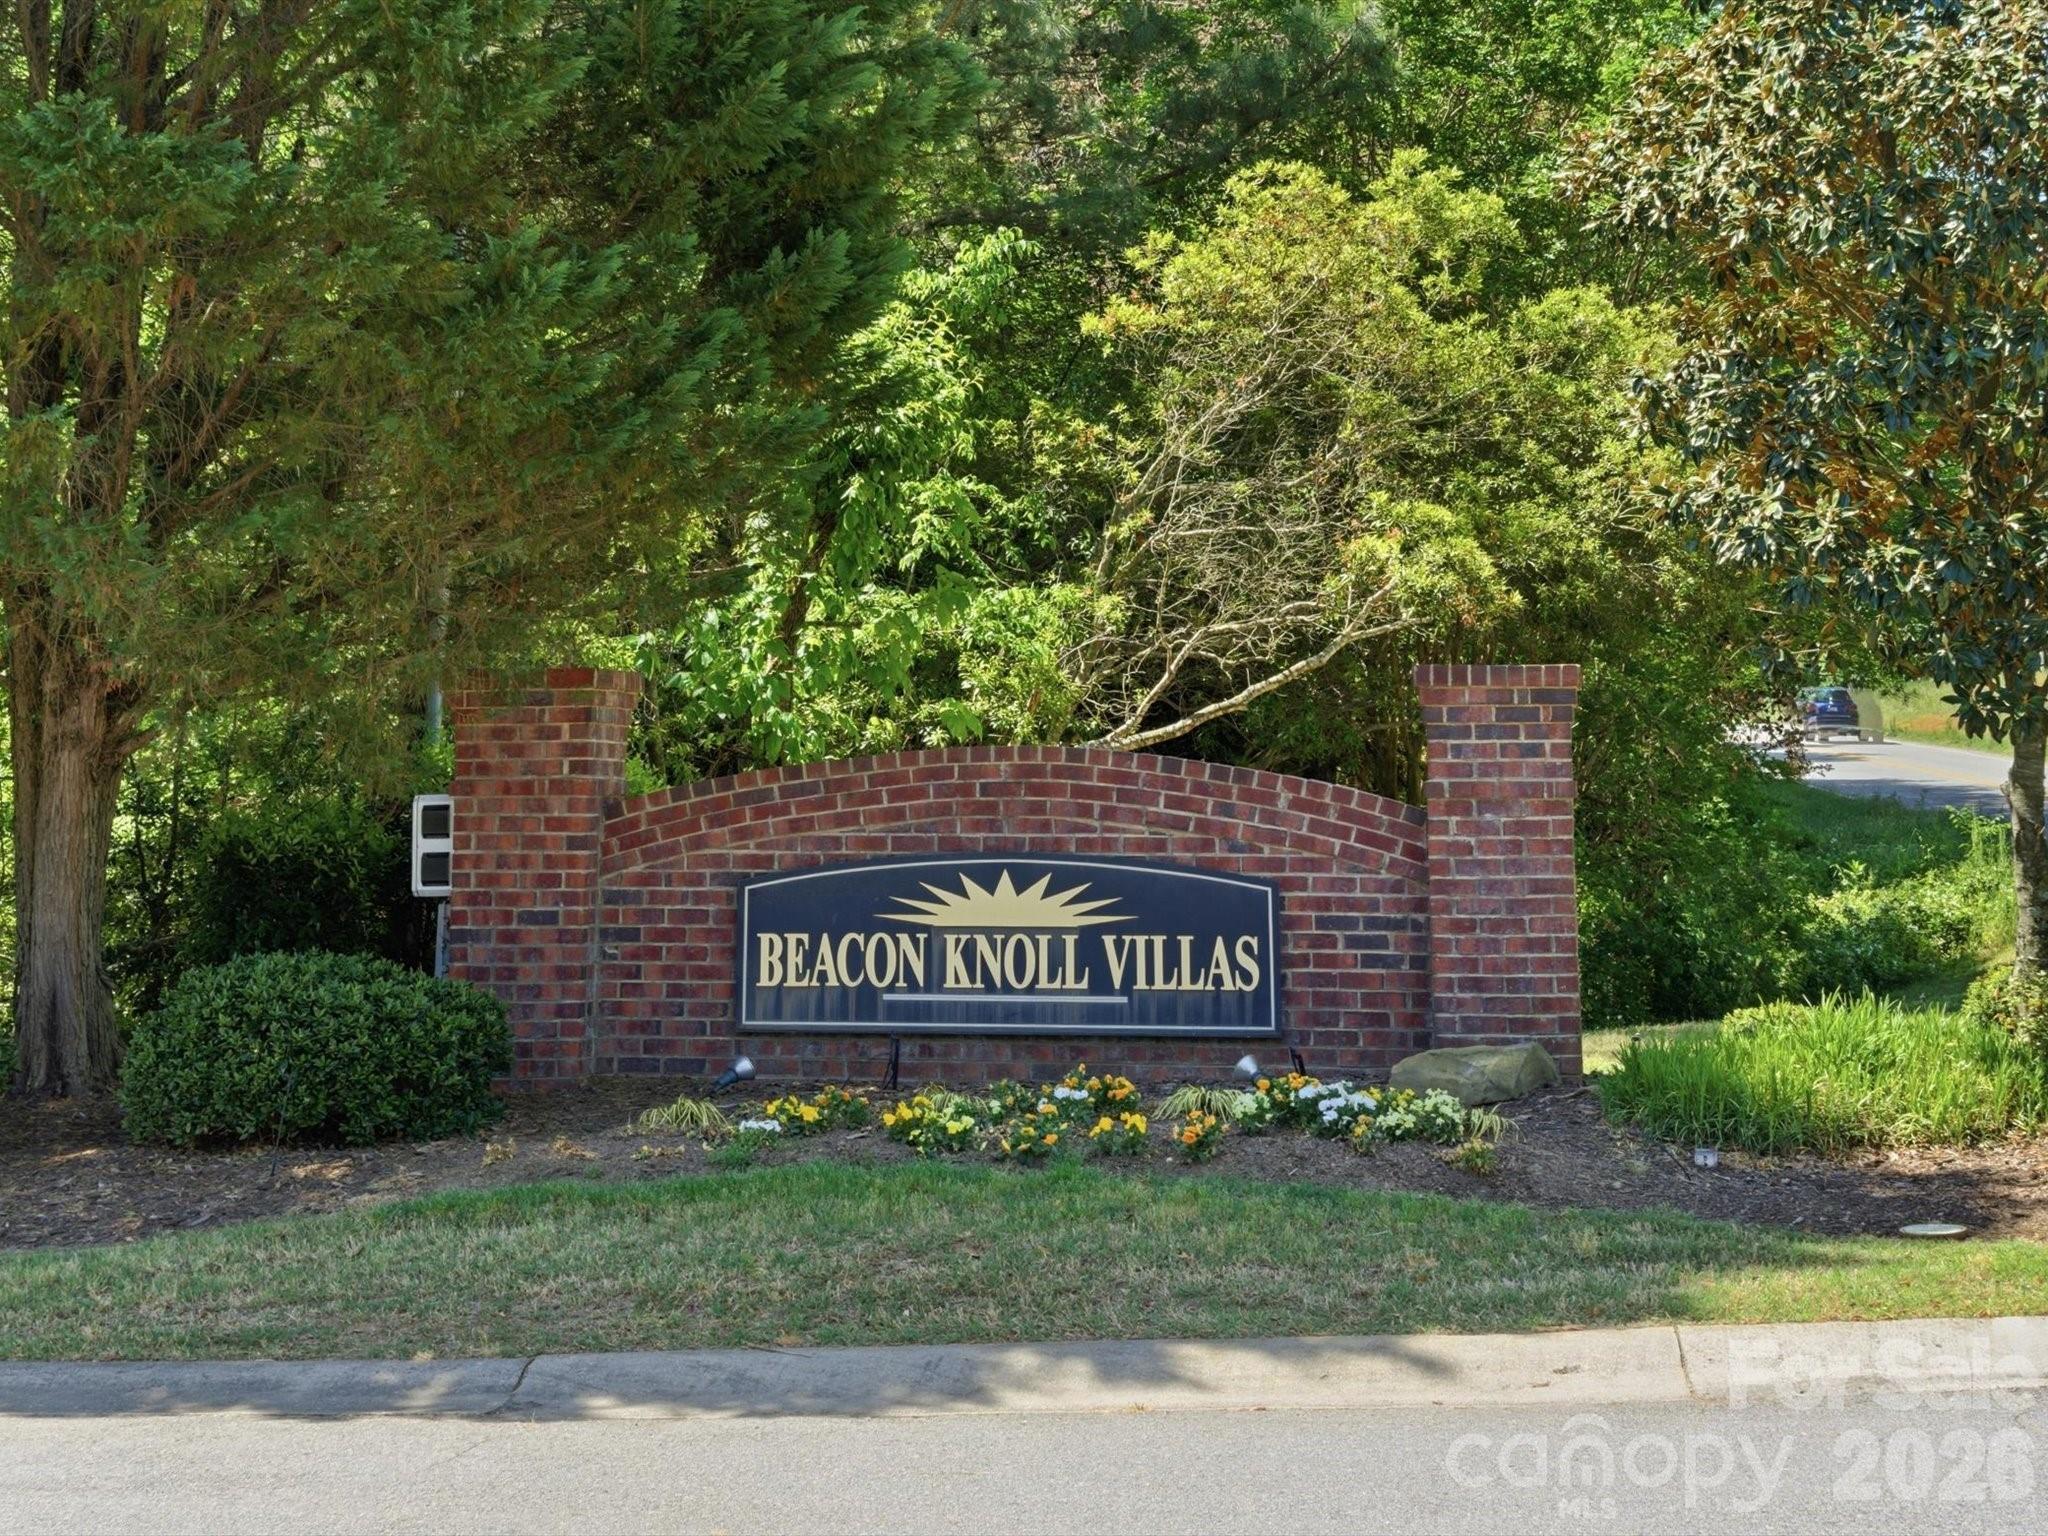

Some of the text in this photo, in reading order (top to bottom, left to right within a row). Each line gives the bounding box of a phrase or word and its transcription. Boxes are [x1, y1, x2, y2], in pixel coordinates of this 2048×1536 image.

[756, 932, 1261, 992] BEACON KNOLL VILLAS
